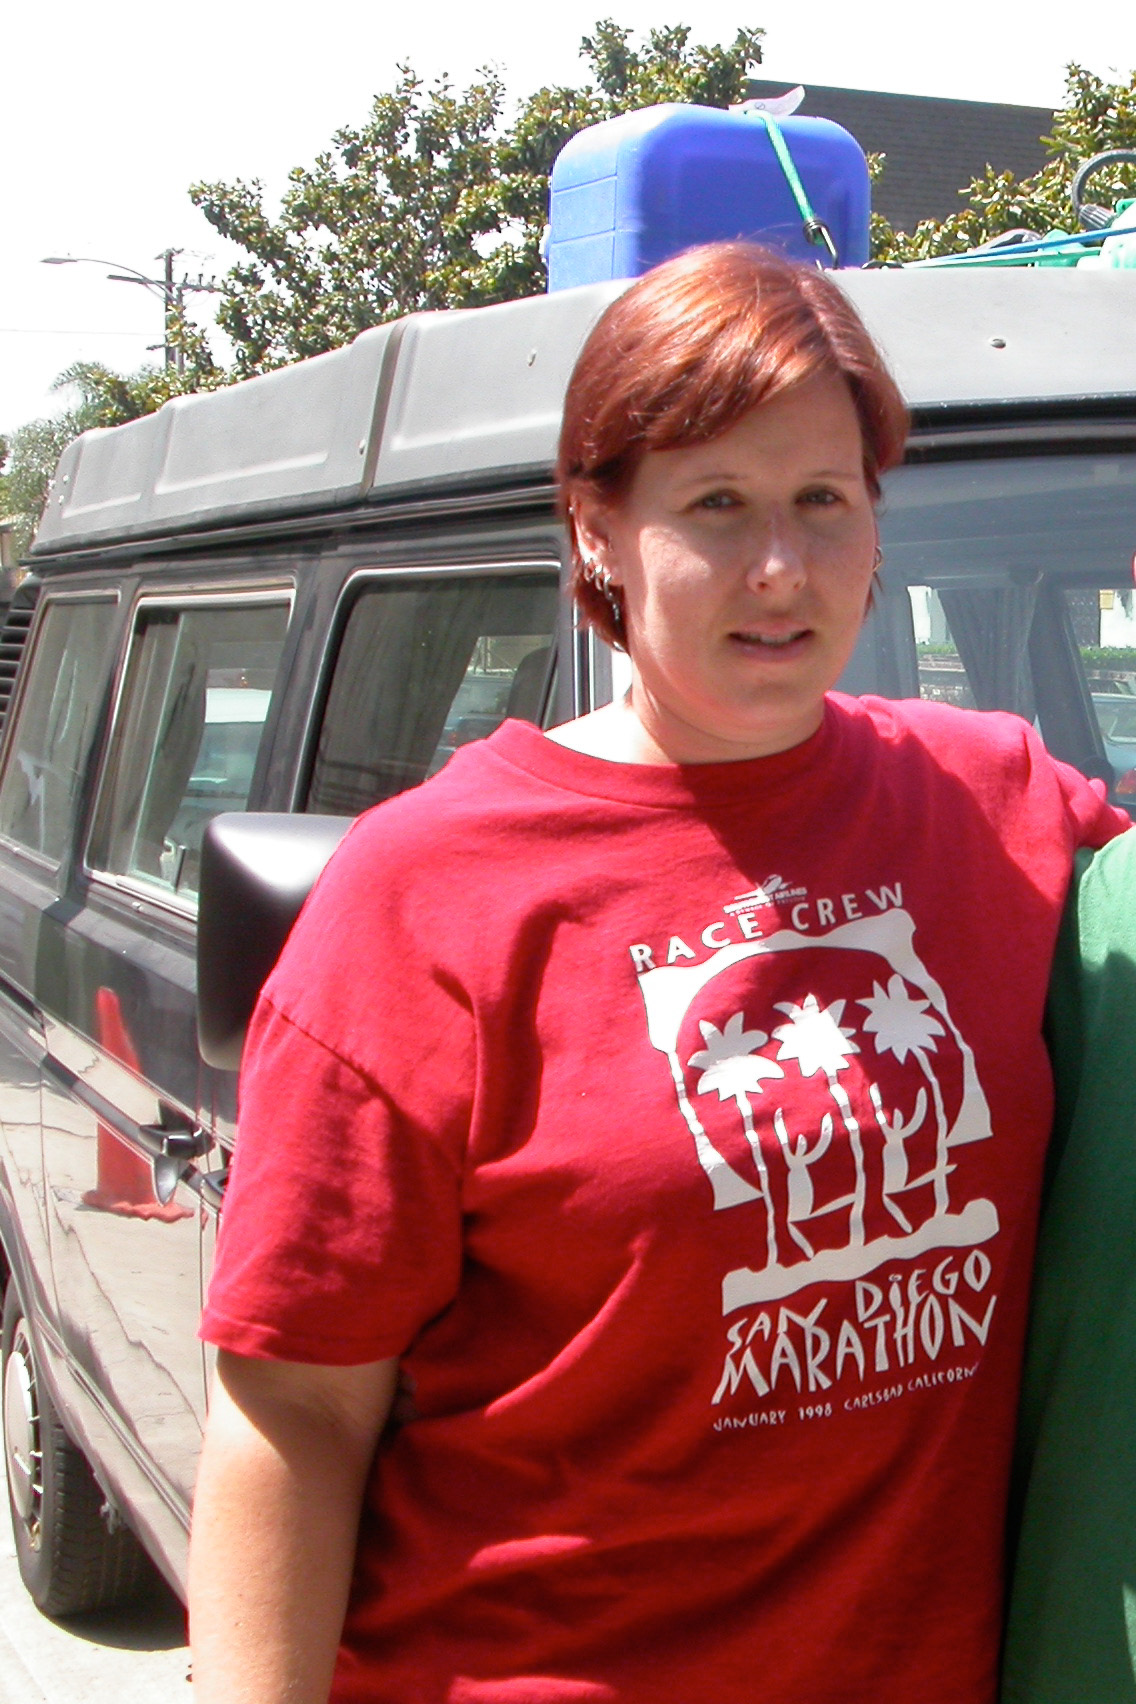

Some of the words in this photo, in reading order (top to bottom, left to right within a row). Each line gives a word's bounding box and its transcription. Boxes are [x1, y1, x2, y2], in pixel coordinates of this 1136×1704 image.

[629, 913, 763, 972] RACE
[791, 882, 903, 931] CREW
[711, 1294, 997, 1405] MARATHON
[726, 1298, 828, 1355] SAN
[713, 1409, 787, 1432] JANUARY
[797, 1402, 833, 1421] 1998
[843, 1384, 904, 1411] CARLSBAD
